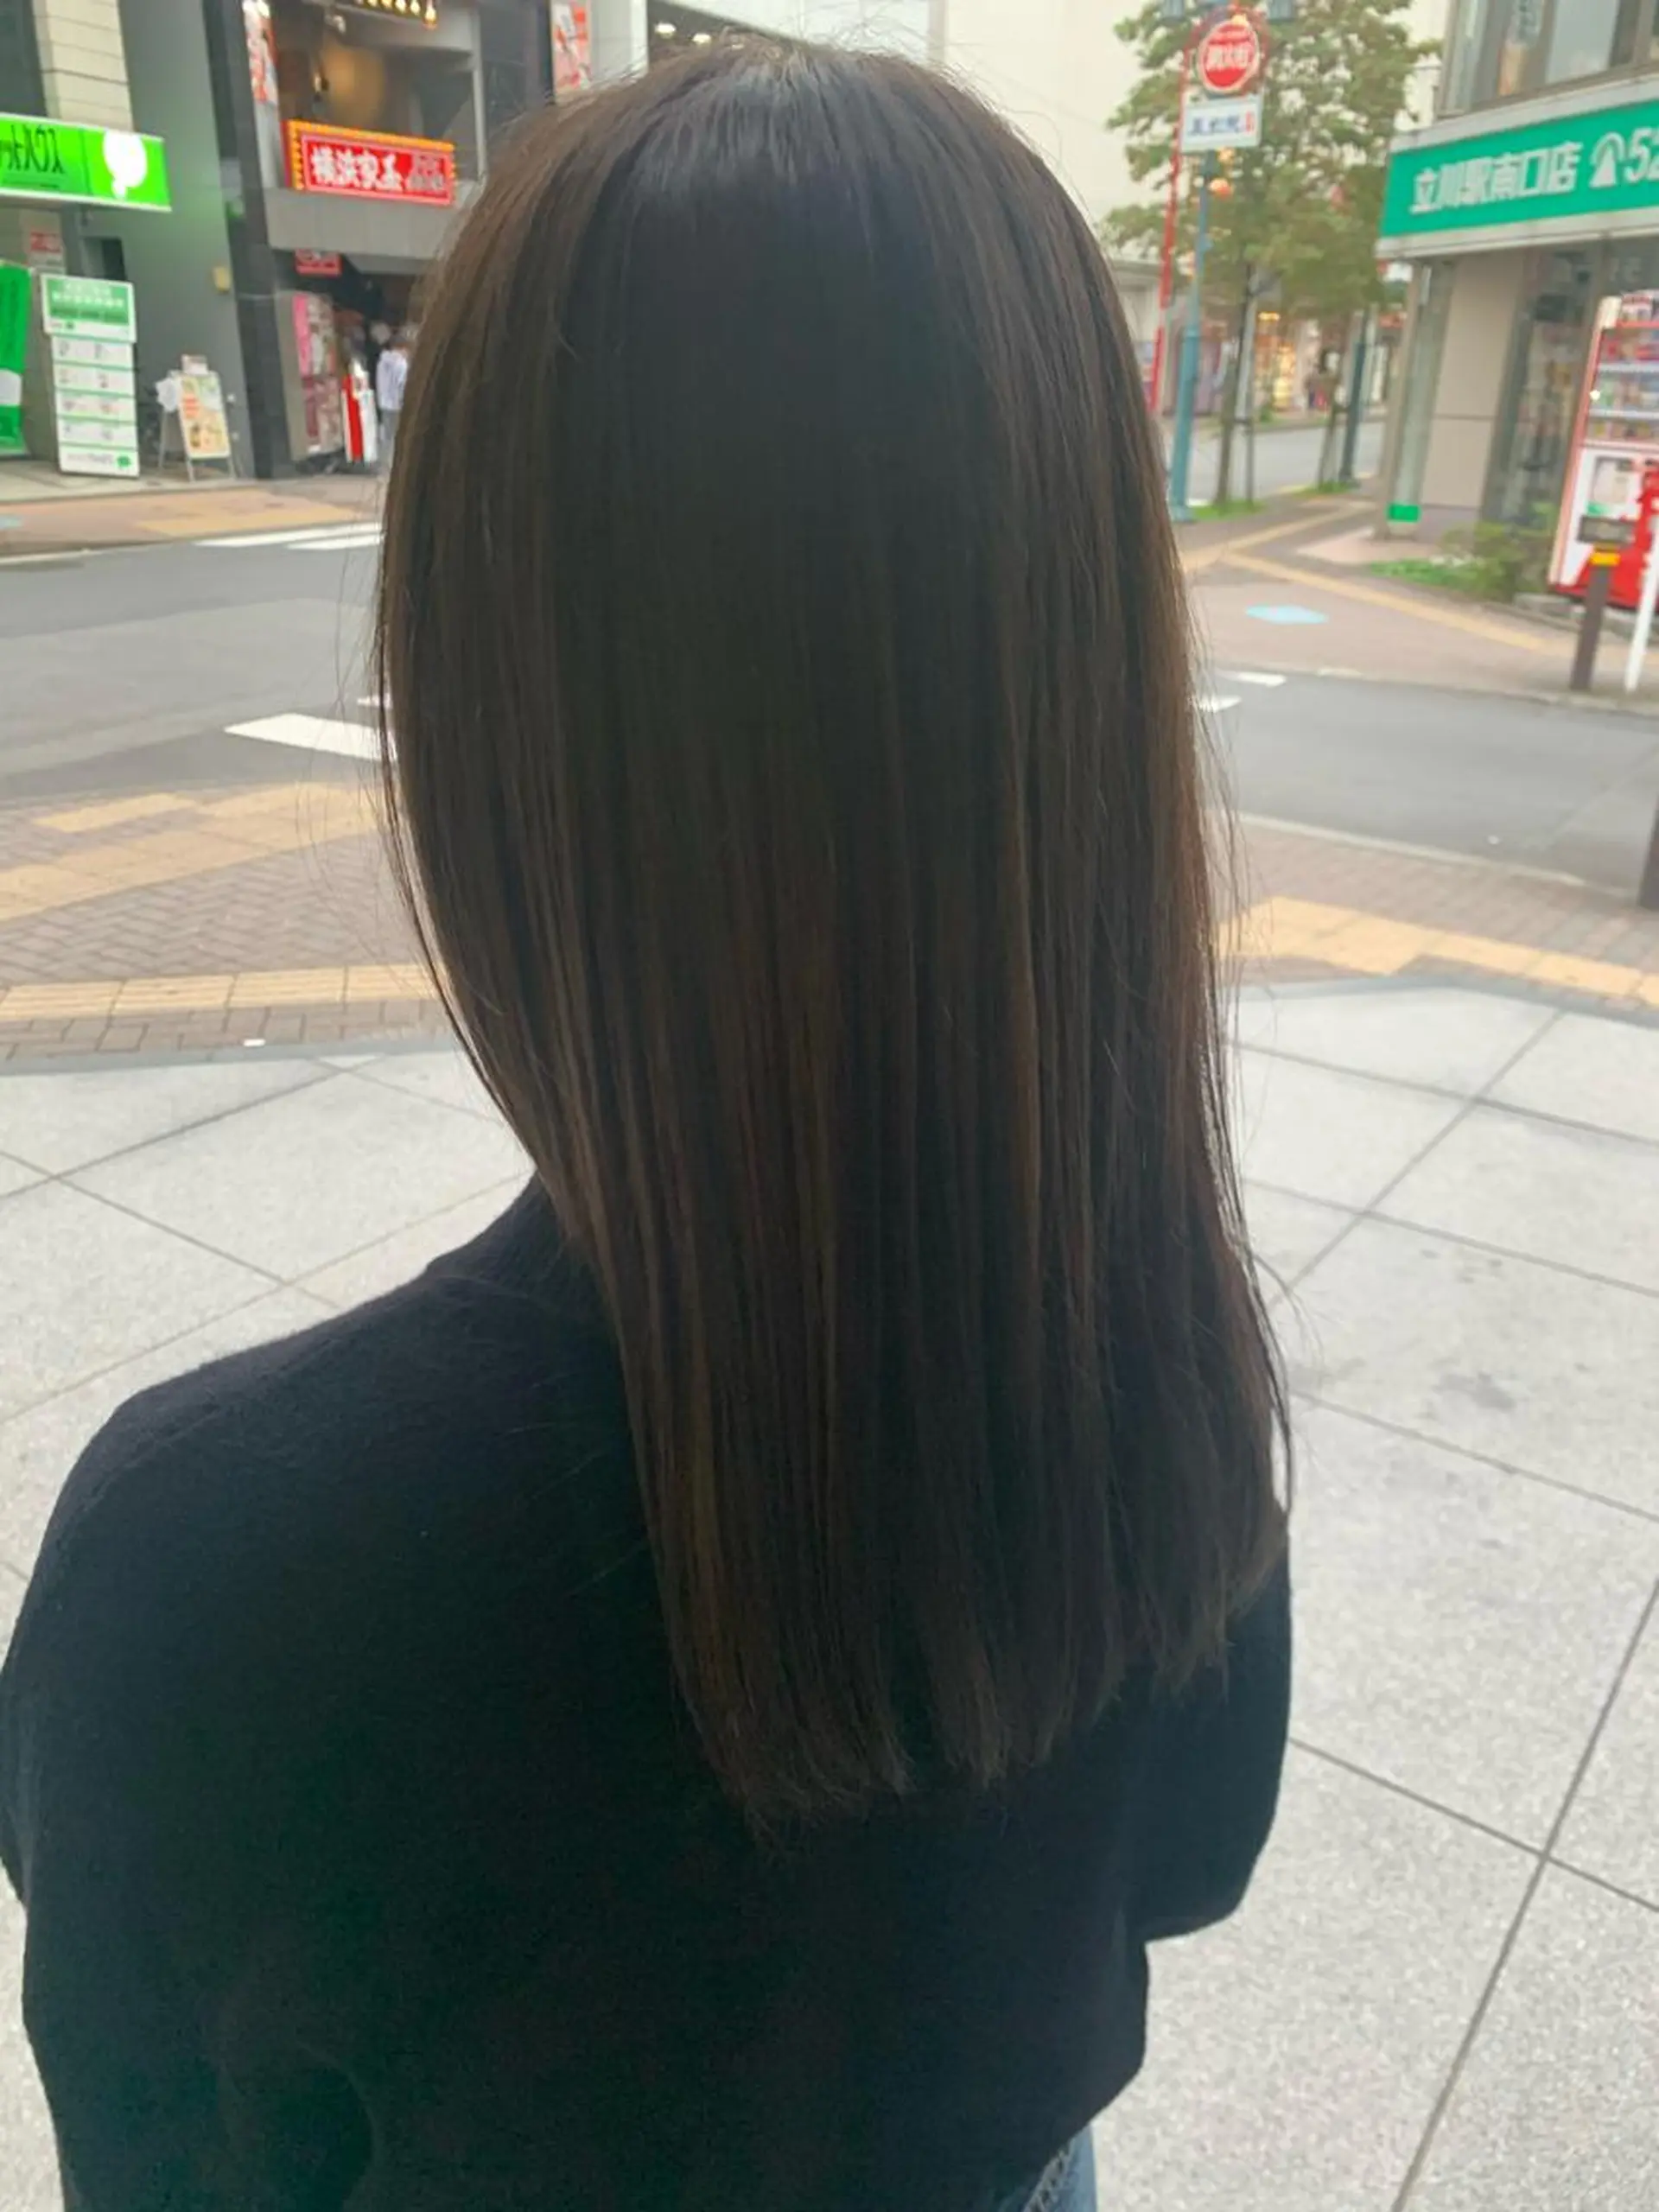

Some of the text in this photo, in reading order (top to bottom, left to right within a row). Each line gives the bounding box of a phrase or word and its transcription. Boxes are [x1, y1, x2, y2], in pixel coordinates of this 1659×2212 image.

[1409, 141, 1583, 215] 立川駅南口店
